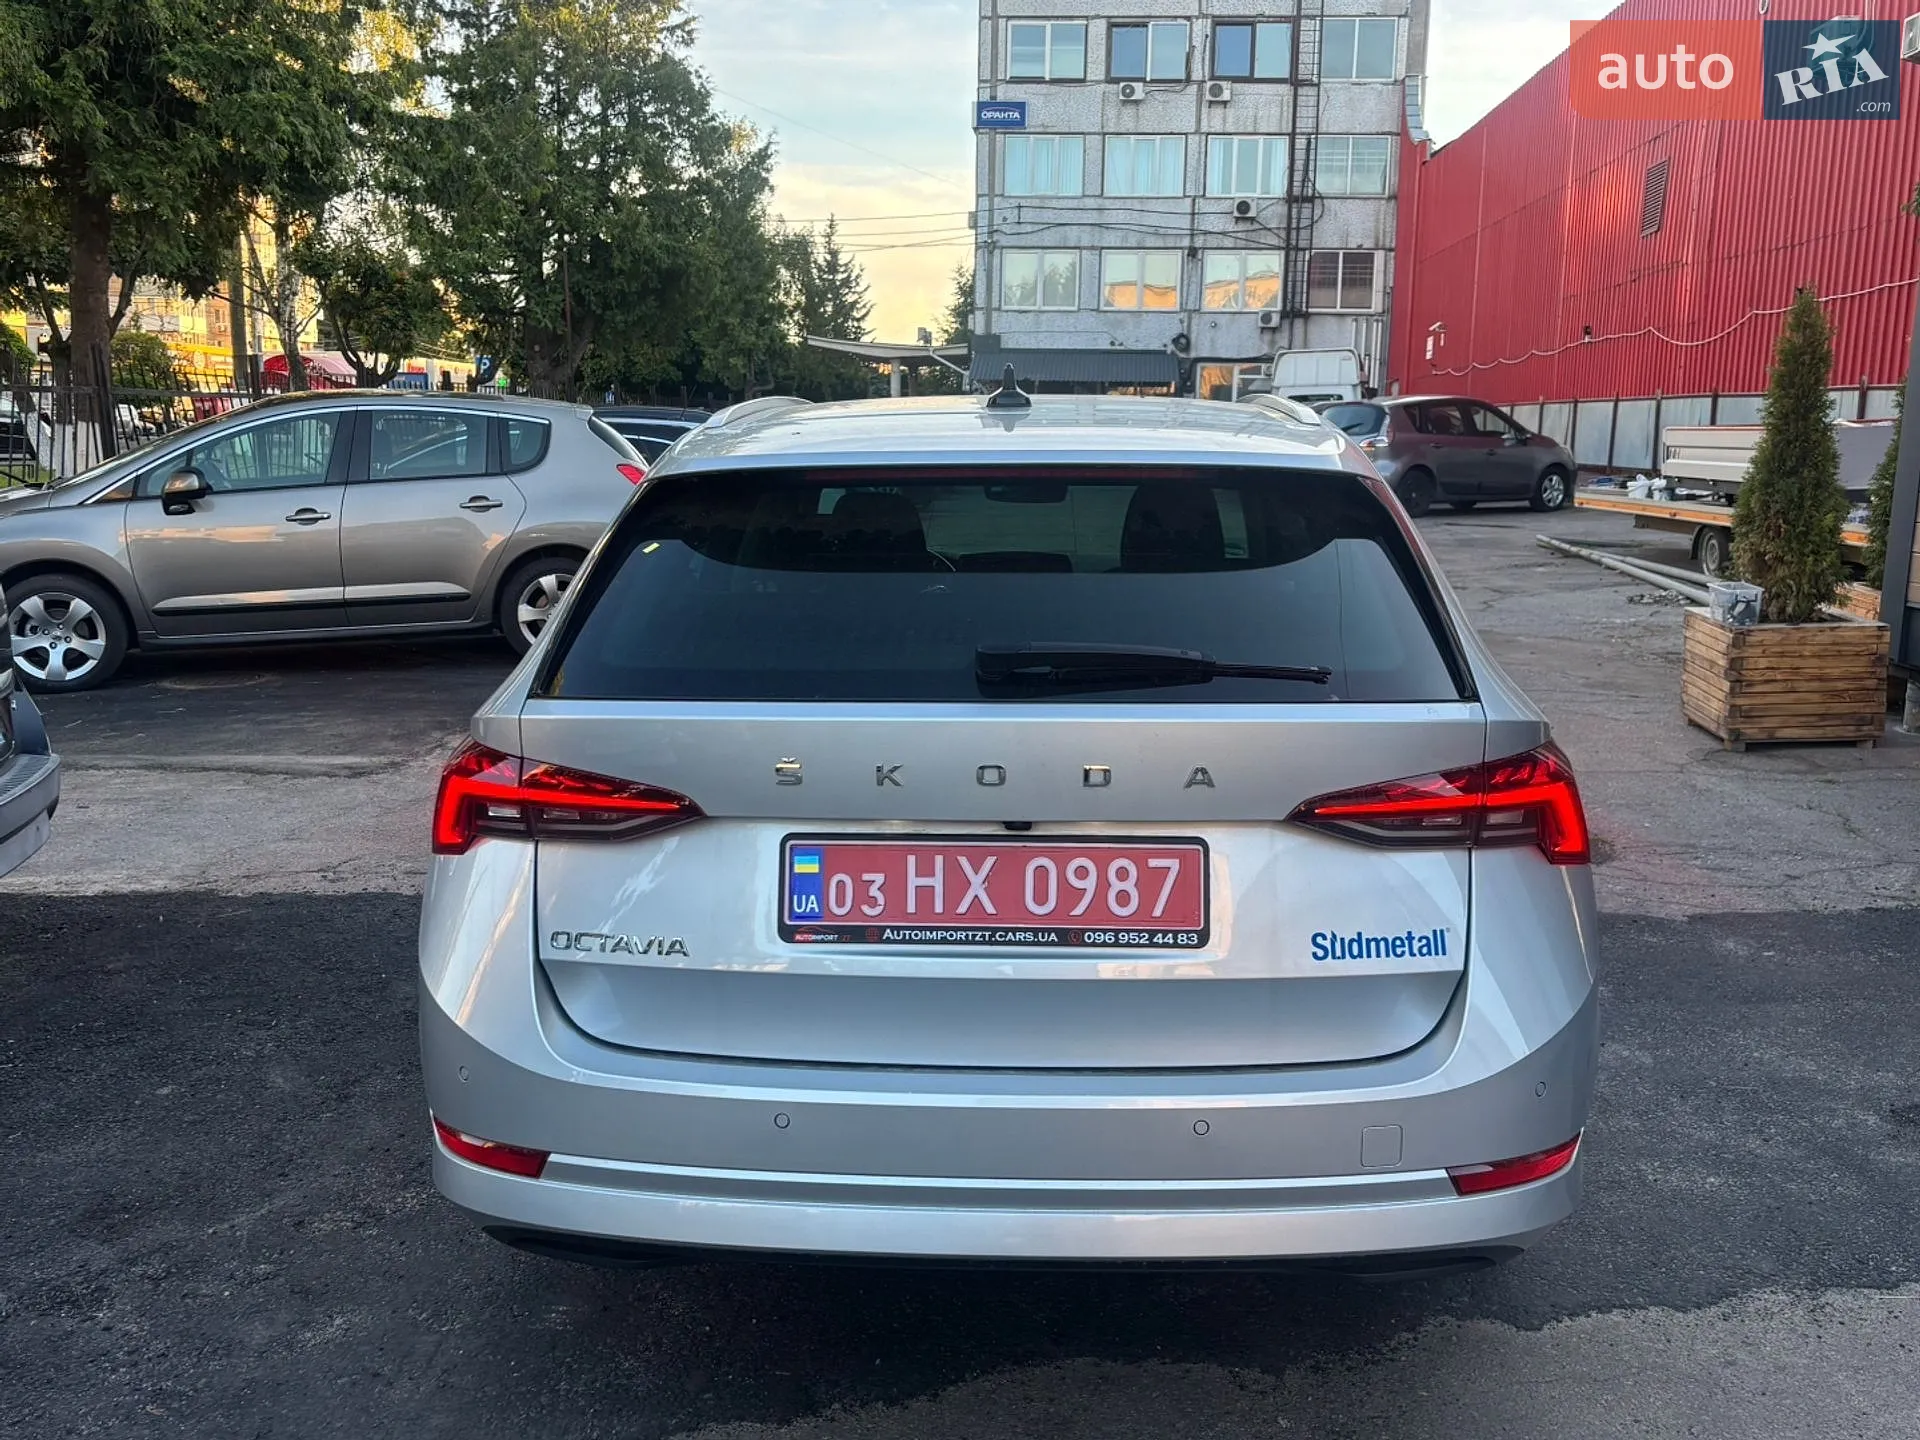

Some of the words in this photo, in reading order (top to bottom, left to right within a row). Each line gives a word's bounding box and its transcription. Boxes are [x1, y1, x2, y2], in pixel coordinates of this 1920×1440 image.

[981, 110, 1021, 119] ОРАНТА
[828, 873, 887, 917] 03
[906, 854, 998, 915] HX
[1025, 856, 1181, 918] 0987
[792, 895, 820, 913] UA
[550, 930, 691, 957] OCTAVIA
[1083, 931, 1115, 944] 096
[1118, 932, 1150, 945] 952
[1152, 933, 1174, 945] 44
[1177, 933, 1199, 945] 83
